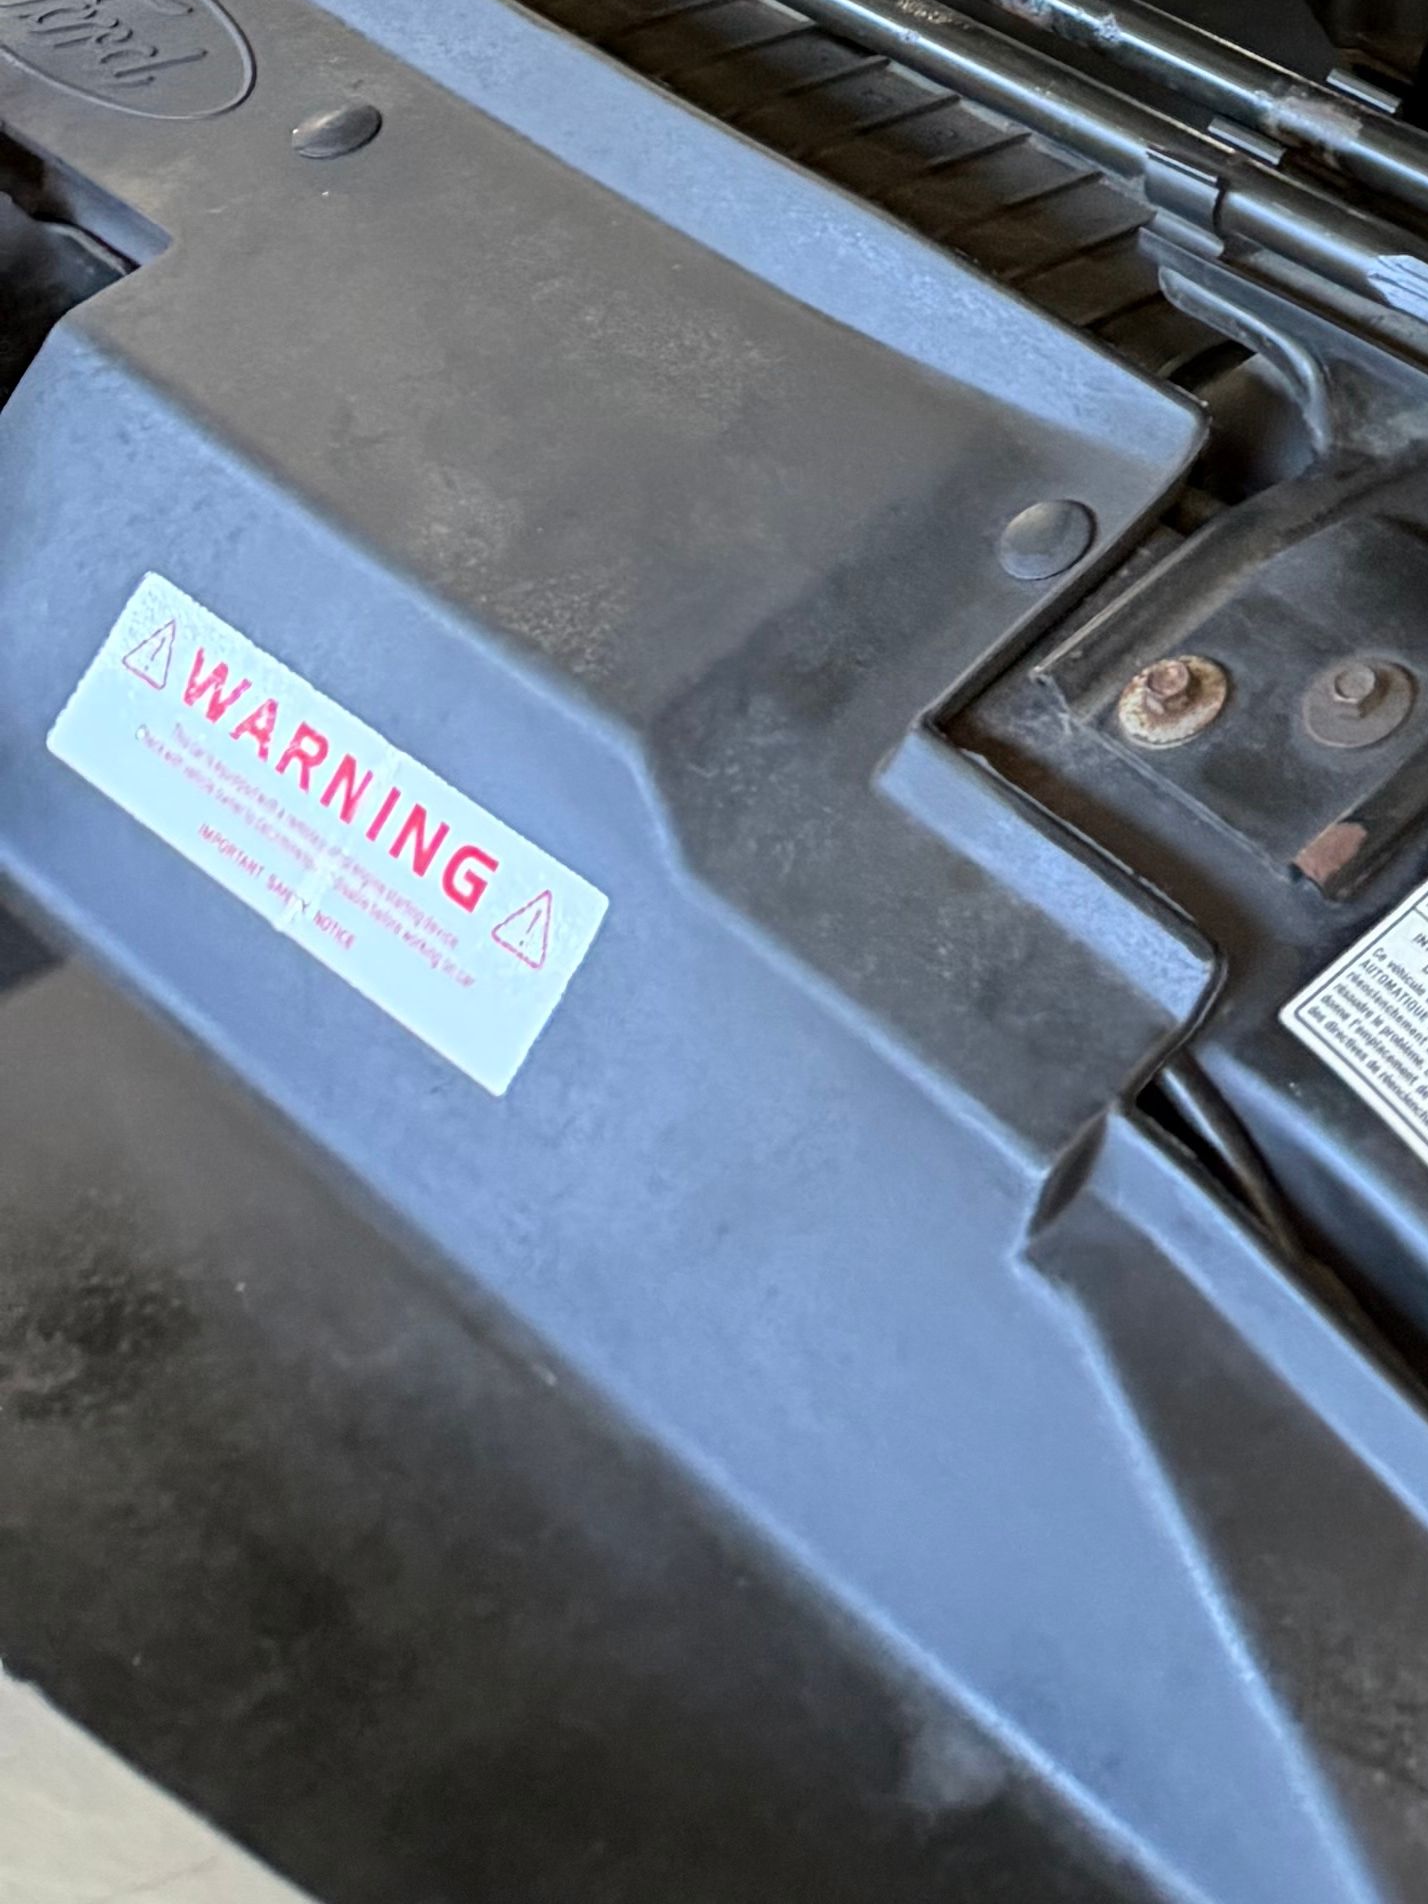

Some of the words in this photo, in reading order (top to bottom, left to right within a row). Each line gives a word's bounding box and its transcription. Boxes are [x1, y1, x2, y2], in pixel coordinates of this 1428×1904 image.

[183, 647, 500, 913] WARNING
[195, 820, 265, 880] IMPORTANT
[310, 908, 357, 951] NOTICE
[1371, 945, 1390, 963] Ce
[1385, 957, 1428, 998] véhicule
[1348, 1016, 1420, 1086] l'emplacement
